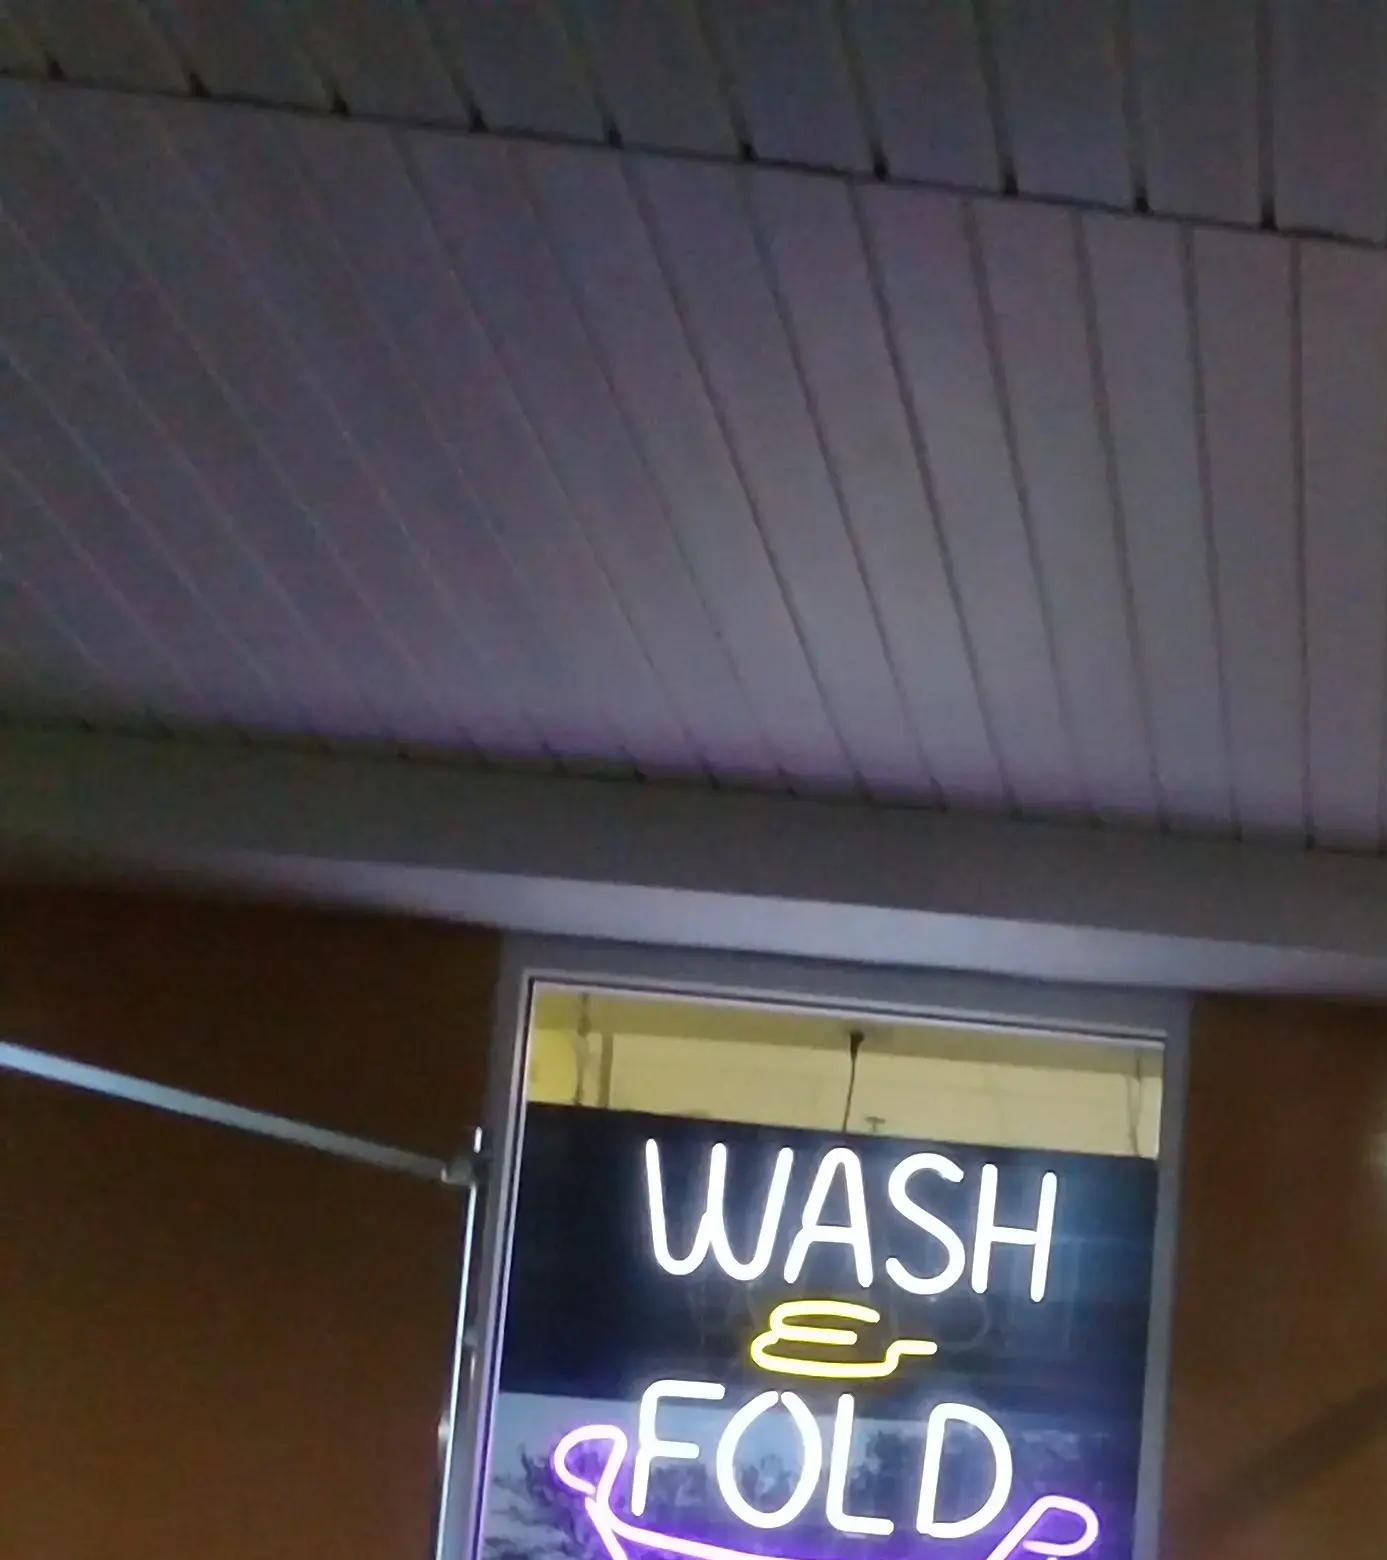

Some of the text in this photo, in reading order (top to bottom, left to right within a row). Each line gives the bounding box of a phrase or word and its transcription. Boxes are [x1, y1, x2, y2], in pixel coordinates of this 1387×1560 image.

[645, 1138, 1058, 1302] WASH
[750, 1300, 939, 1378] &
[632, 1379, 1013, 1540] FOLD
